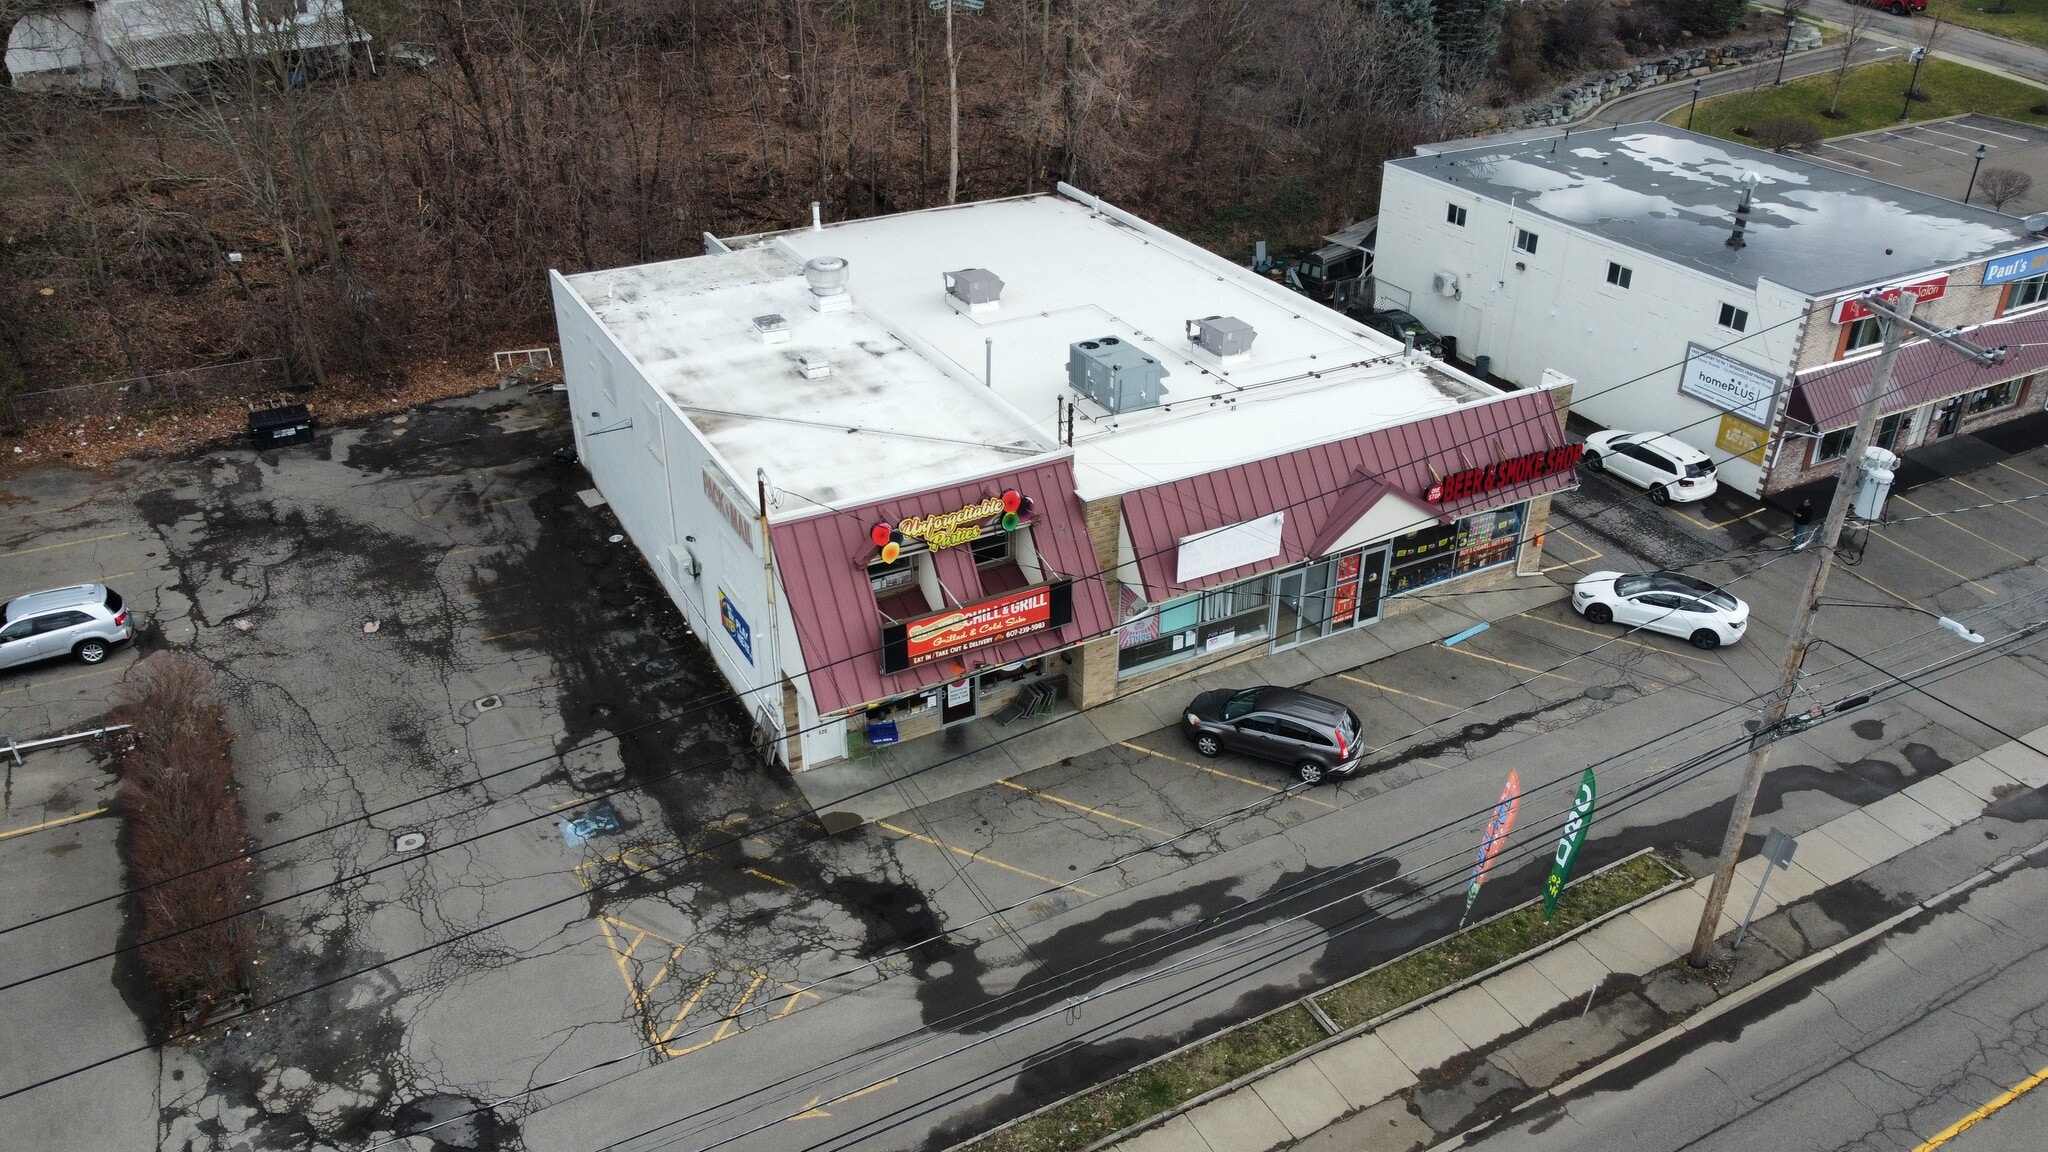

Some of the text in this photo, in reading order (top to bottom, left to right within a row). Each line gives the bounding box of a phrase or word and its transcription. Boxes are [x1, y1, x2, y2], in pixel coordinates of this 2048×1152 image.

[1986, 259, 2028, 281] Paul's
[1917, 284, 1940, 298] Salon
[1699, 371, 1755, 402] homePLUS
[1442, 443, 1584, 503] BEER & SMOKE SHOP
[1428, 492, 1442, 501] STOP
[730, 503, 754, 551] MAIL
[899, 497, 1005, 540] Unforgettable
[929, 525, 981, 553] Parties
[963, 606, 1002, 627] CHILL
[1010, 593, 1048, 615] GRILL
[933, 615, 1027, 647] Grilled & Cold Subs
[1219, 625, 1236, 635] LEASE
[913, 656, 924, 664] EAT
[925, 653, 932, 661] IN
[935, 649, 949, 658] TAKE
[949, 645, 963, 654] OUT
[969, 637, 994, 649] DELIVERY
